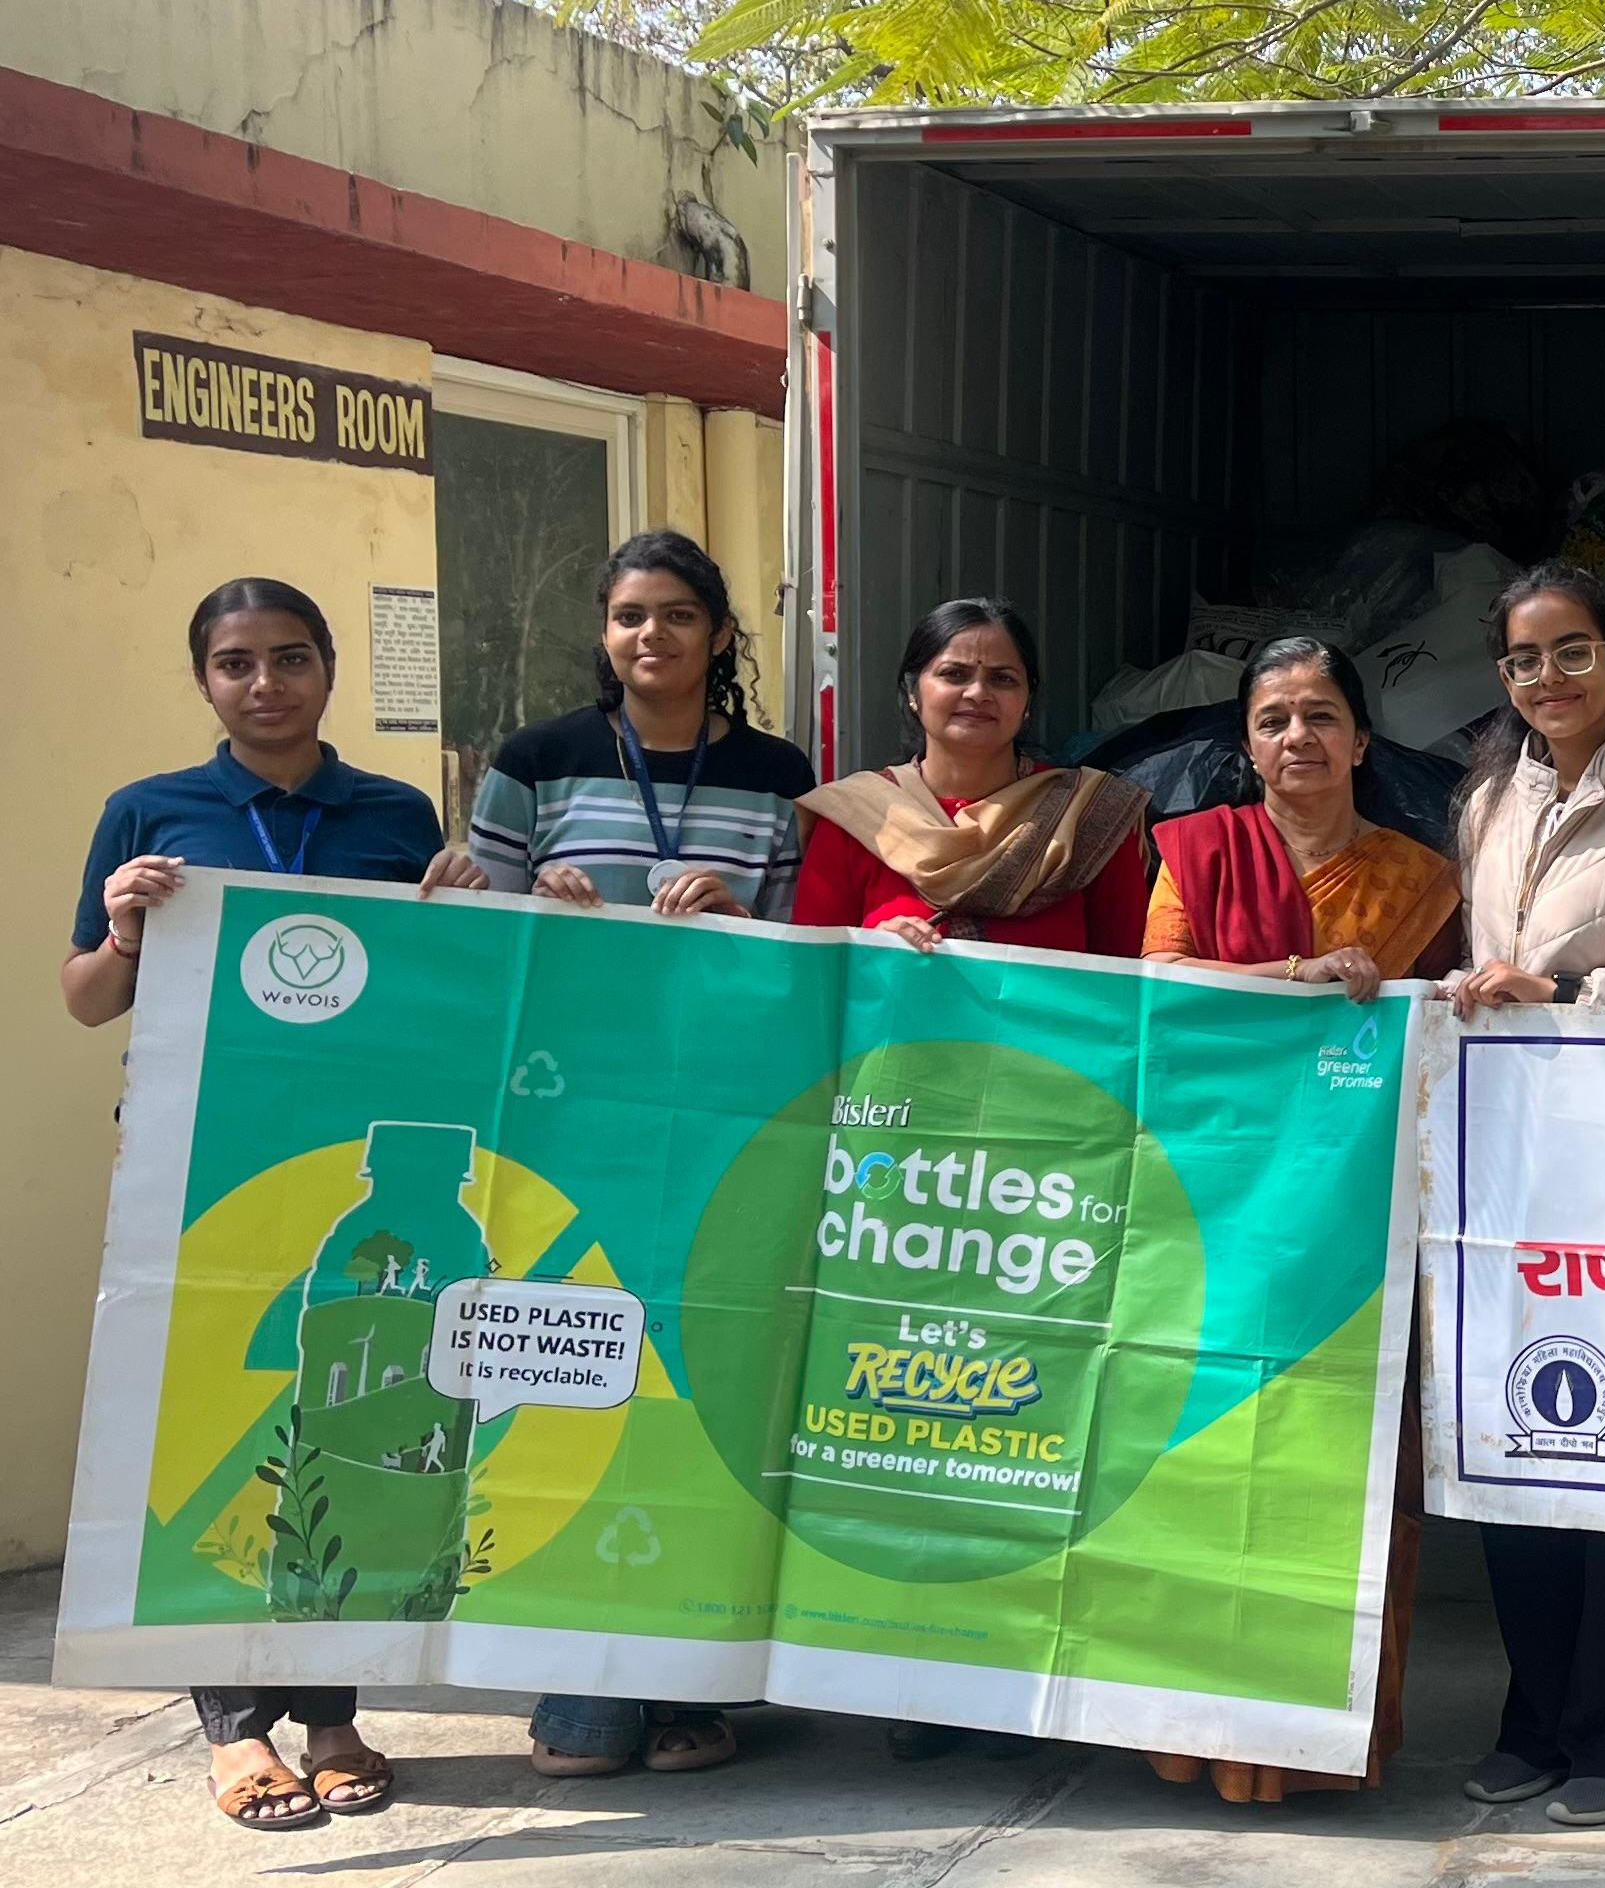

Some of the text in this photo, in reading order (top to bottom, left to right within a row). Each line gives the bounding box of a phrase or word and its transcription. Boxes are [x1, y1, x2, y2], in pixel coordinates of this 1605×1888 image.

[143, 347, 425, 459] ENGINEERS ROOM
[1317, 1060, 1371, 1076] greener
[1330, 1075, 1383, 1091] promise
[830, 1094, 912, 1127] Bisleri
[824, 1133, 1127, 1223] bottles for
[817, 1201, 1095, 1294] change
[460, 1302, 624, 1331] USED PLASTIC
[451, 1330, 625, 1360] IS NOT WASTE!
[459, 1361, 608, 1387] It is recyclable.
[805, 1404, 1065, 1463] USED PLASTIC
[790, 1433, 1080, 1492] for a greener tomorrow!
